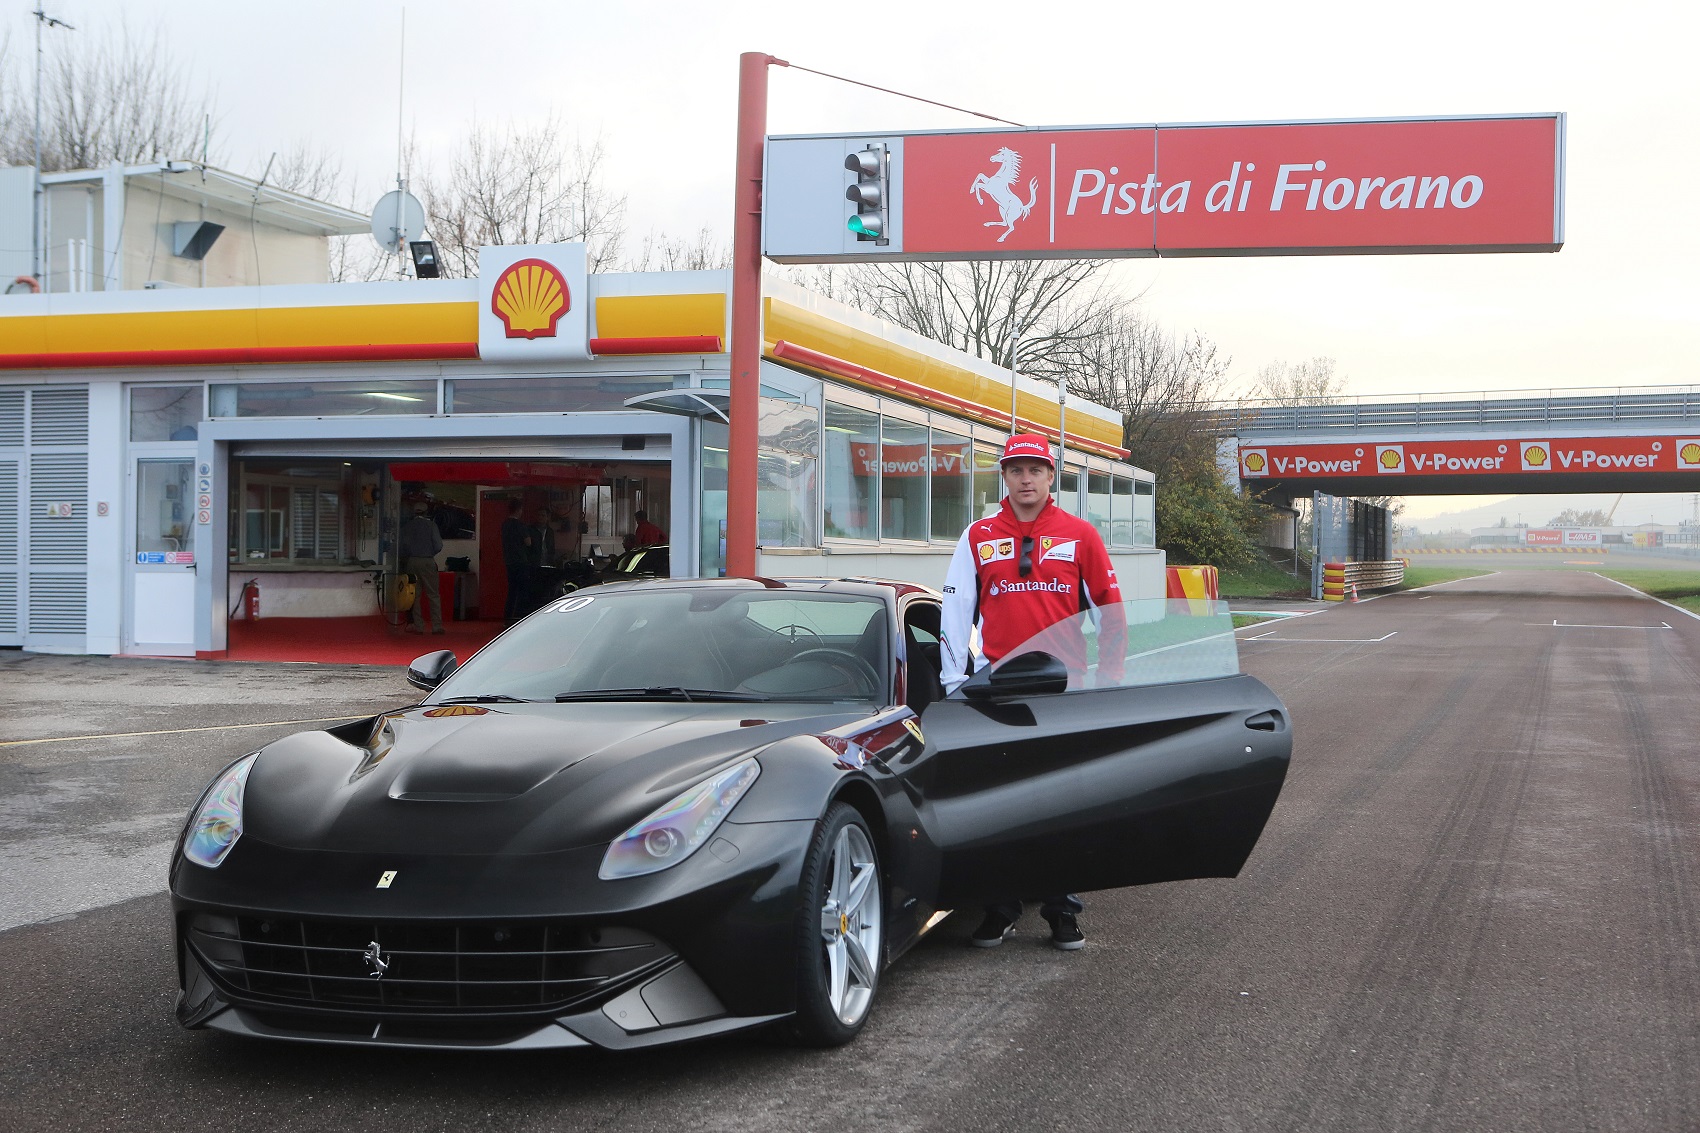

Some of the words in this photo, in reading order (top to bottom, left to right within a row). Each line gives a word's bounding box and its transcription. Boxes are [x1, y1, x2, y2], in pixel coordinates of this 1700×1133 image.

[1067, 166, 1191, 216] Pista
[1204, 161, 1256, 213] di
[1269, 160, 1484, 212] Fiorano
[1013, 442, 1045, 452] Santander
[1273, 457, 1362, 474] V-Power
[1410, 453, 1504, 471] V-Power
[1557, 450, 1659, 468] V-Power
[1000, 545, 1012, 554] ups
[1000, 578, 1071, 593] Santander
